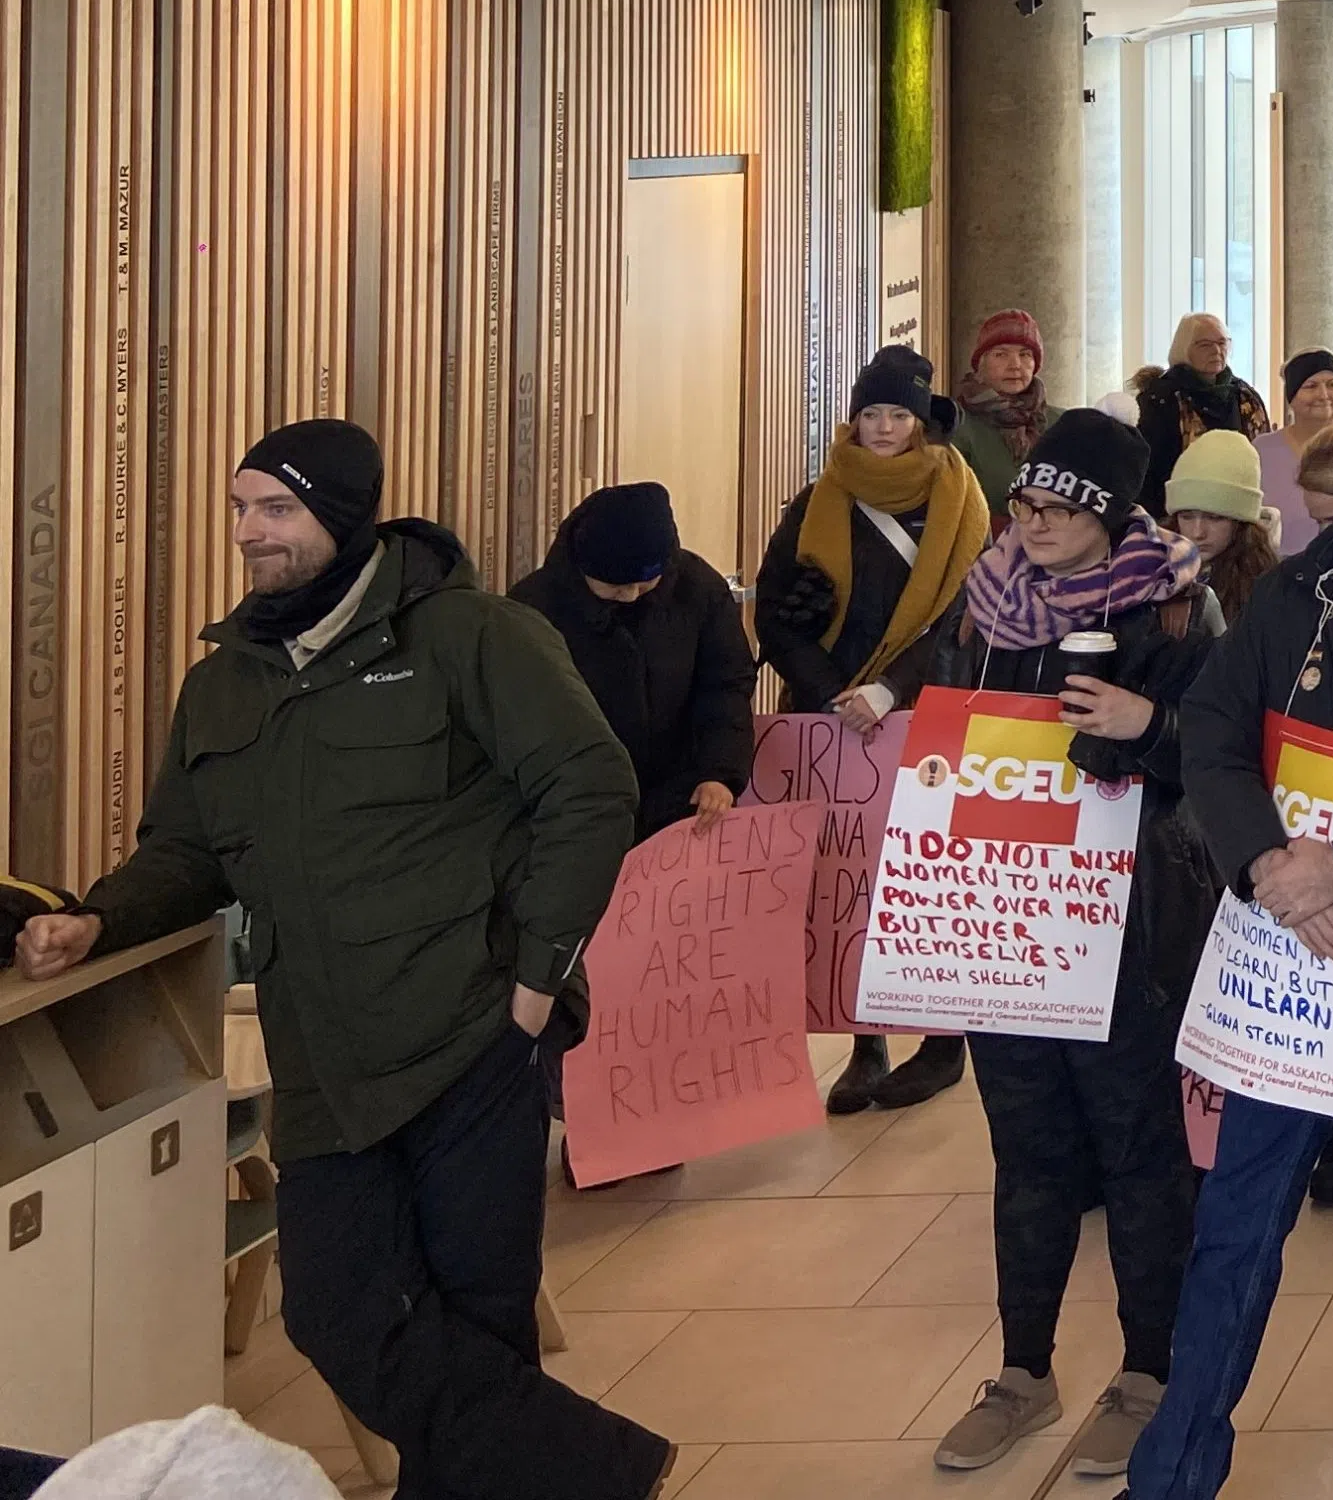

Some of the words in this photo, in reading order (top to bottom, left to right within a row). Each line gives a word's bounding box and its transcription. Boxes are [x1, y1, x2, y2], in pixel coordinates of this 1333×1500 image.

[118, 164, 131, 231] MAZUR
[492, 179, 502, 225] FIRMS
[118, 234, 131, 257] M.
[118, 262, 130, 275] &
[118, 278, 130, 294] T.
[491, 231, 500, 322] LANDSCAPE
[116, 326, 128, 393] MYERS
[809, 298, 820, 423] KRAMER
[116, 396, 128, 416] C.
[158, 342, 169, 432] MASTERS
[115, 421, 127, 434] &
[517, 370, 535, 497] CARES
[114, 436, 127, 520] ROURKE
[114, 522, 126, 542] R.
[28, 482, 57, 700] CANADA
[113, 577, 126, 656] POOLER
[113, 659, 125, 677] S.
[113, 682, 124, 696] &
[113, 699, 125, 716] J.
[750, 719, 884, 805] GIRLS
[955, 754, 1084, 805] SGEU
[112, 749, 124, 835] BEAUDIN
[621, 802, 817, 886] WOMEN'S
[919, 830, 974, 862] DO
[984, 841, 1060, 869] NOT
[1069, 849, 1135, 876] WISH
[617, 863, 793, 937] RIGHTS
[884, 859, 999, 888] WOMEN
[1006, 872, 1039, 892] TO
[1049, 873, 1112, 898] HAVE
[882, 885, 986, 911] POWER
[992, 893, 1054, 919] OVER
[1218, 901, 1240, 935] AND
[877, 910, 947, 935] BUT
[951, 917, 1037, 942] OVER
[1212, 930, 1225, 953] TO
[639, 925, 736, 992] ARE
[968, 969, 1046, 991] SHELLEY
[598, 977, 773, 1055] HUMAN
[865, 990, 925, 1004] WORKING
[926, 993, 985, 1008] TOGETHER
[987, 998, 1010, 1010] FOR
[1012, 1000, 1105, 1016] SASKATCHEWAN
[977, 1009, 994, 1020] and
[995, 1010, 1029, 1022] General
[1078, 1016, 1103, 1027] Union
[1184, 1024, 1215, 1048] WORKING
[1215, 1040, 1258, 1066] TOGETHER
[1258, 1056, 1280, 1072] FOR
[1245, 1024, 1324, 1059] STENIEM
[609, 1032, 807, 1125] RIGHTS
[1249, 1067, 1264, 1080] and
[1264, 1073, 1296, 1089] General
